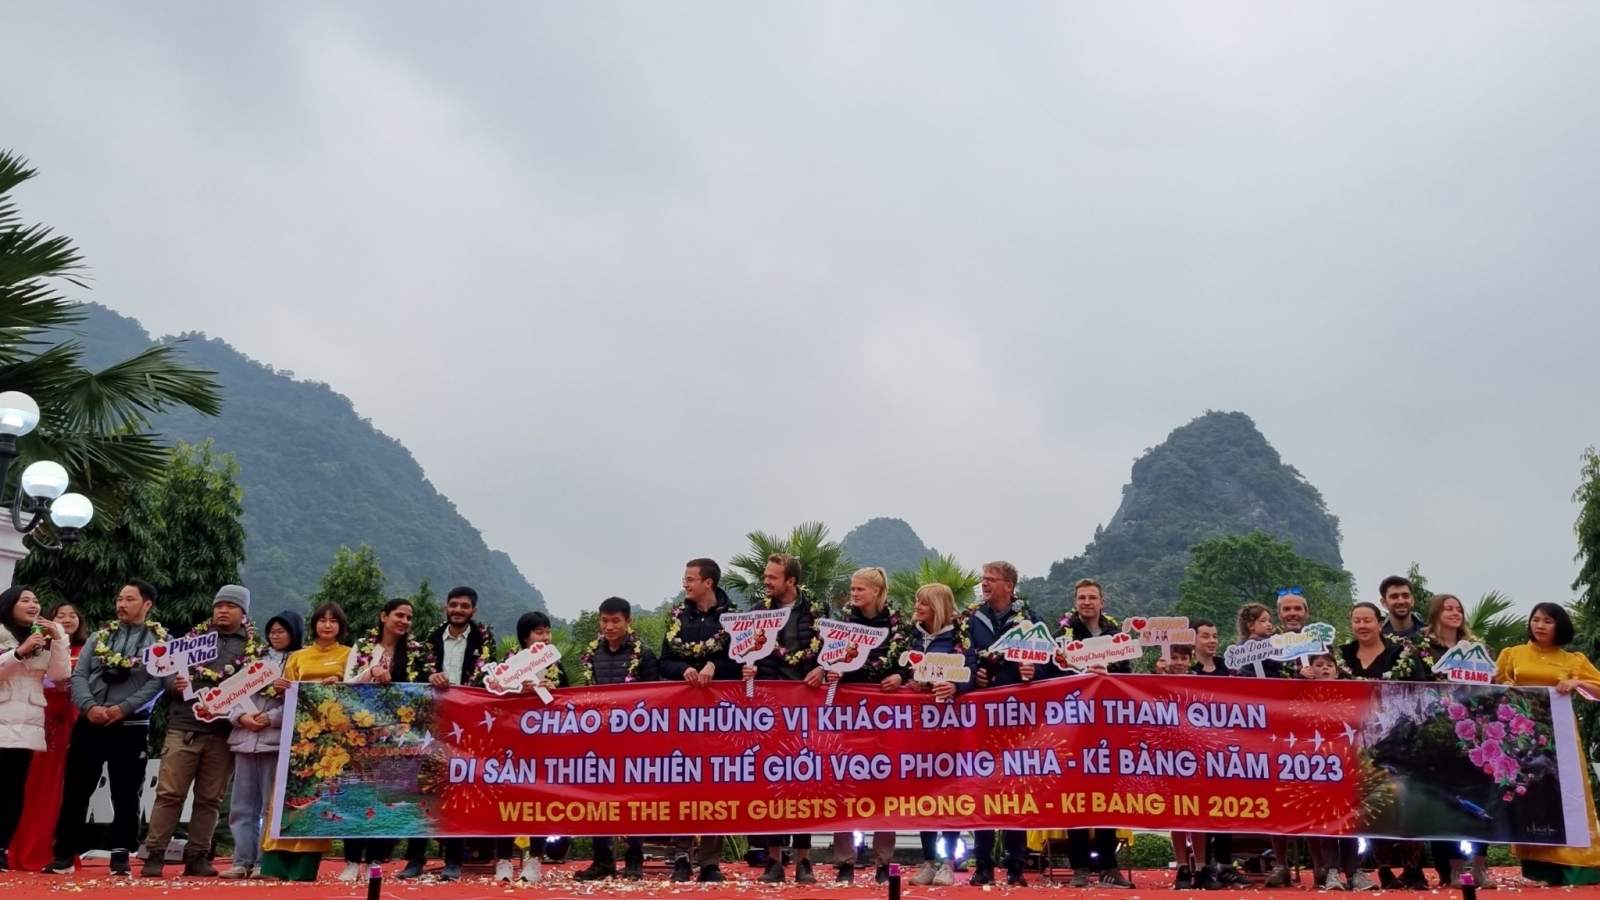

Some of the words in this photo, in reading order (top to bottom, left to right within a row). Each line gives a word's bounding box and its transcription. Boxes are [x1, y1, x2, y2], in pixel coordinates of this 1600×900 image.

[732, 621, 753, 631] ZIP
[756, 618, 783, 629] LINE
[169, 633, 217, 655] Phong
[827, 628, 849, 640] ZIP
[850, 633, 878, 646] LINE
[187, 648, 217, 665] Nha
[520, 704, 601, 734] CHÀO
[609, 702, 669, 732] ĐÓN
[678, 702, 775, 732] NHỮNG
[782, 706, 809, 738] VỊ
[818, 699, 912, 731] KHÁCH
[984, 696, 1036, 727] TIÊN
[1045, 690, 1095, 725] ĐẾN
[1103, 700, 1179, 725] THAM
[1187, 702, 1267, 729] QUAN
[449, 758, 475, 783] DI
[483, 750, 536, 784] SẢN
[544, 751, 616, 783] THIÊN
[624, 750, 702, 783] NHIÊN
[710, 744, 761, 782] THẾ
[763, 748, 822, 782] GIỚI
[830, 755, 892, 782] VQG
[901, 751, 995, 779] PHONG
[1003, 749, 1062, 776] NHA
[1083, 739, 1110, 774] KẺ
[1119, 742, 1198, 777] BÀNG
[1206, 746, 1270, 779] NĂM
[1278, 754, 1344, 782] 2023
[499, 801, 621, 822] WELCOME
[628, 801, 670, 822] THE
[679, 800, 740, 821] FIRST
[748, 799, 837, 820] GUESTS
[843, 798, 876, 817] TO
[884, 795, 976, 817] PHONG
[984, 794, 1039, 815] NHA
[1061, 793, 1086, 814] KE
[1092, 792, 1166, 815] BANG
[1174, 795, 1200, 816] IN
[1208, 796, 1270, 818] 2023
